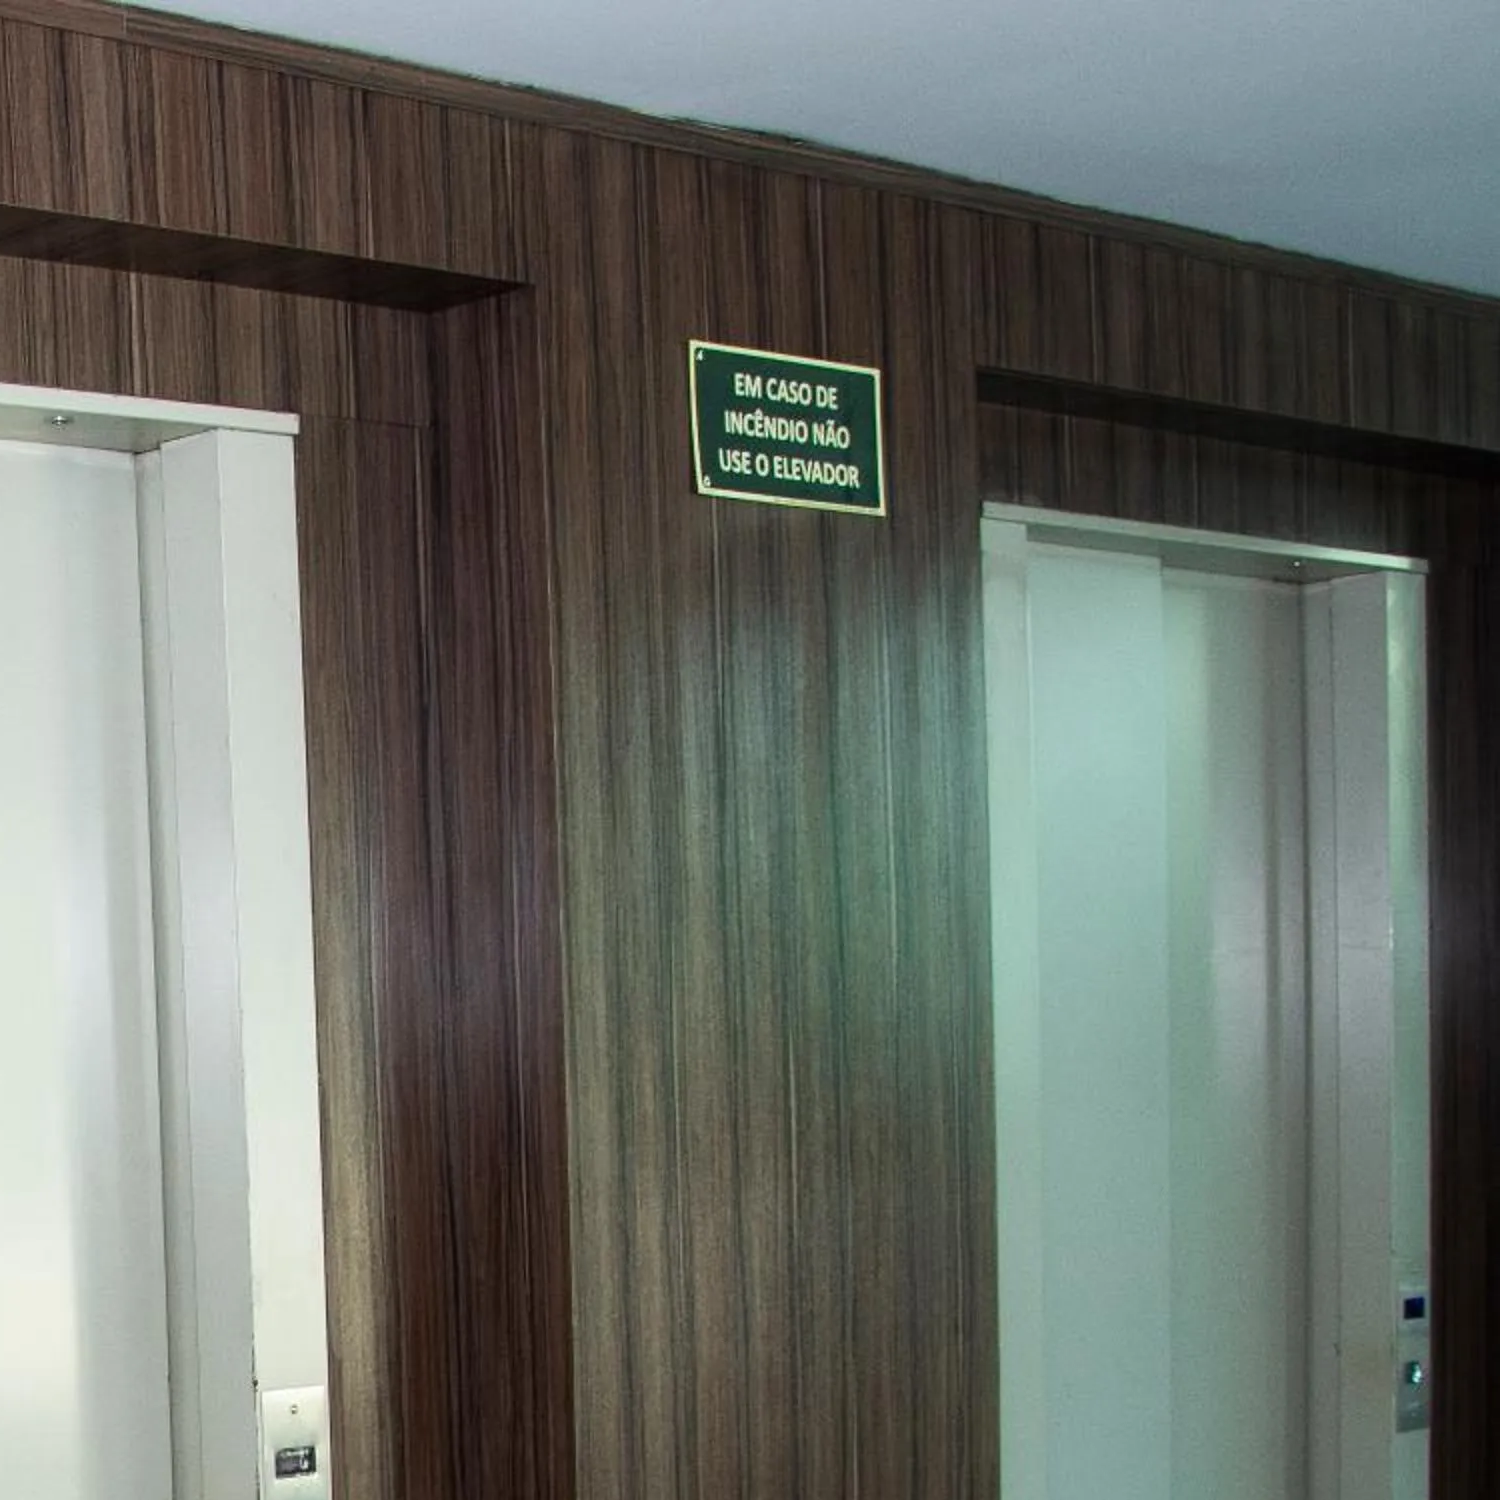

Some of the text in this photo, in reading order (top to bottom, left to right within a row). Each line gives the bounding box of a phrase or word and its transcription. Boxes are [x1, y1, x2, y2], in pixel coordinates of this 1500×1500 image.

[734, 373, 838, 410] EM CASO DE
[725, 409, 850, 449] INCÊNDIO NÃO
[719, 448, 860, 488] USE O ELEVADOR
